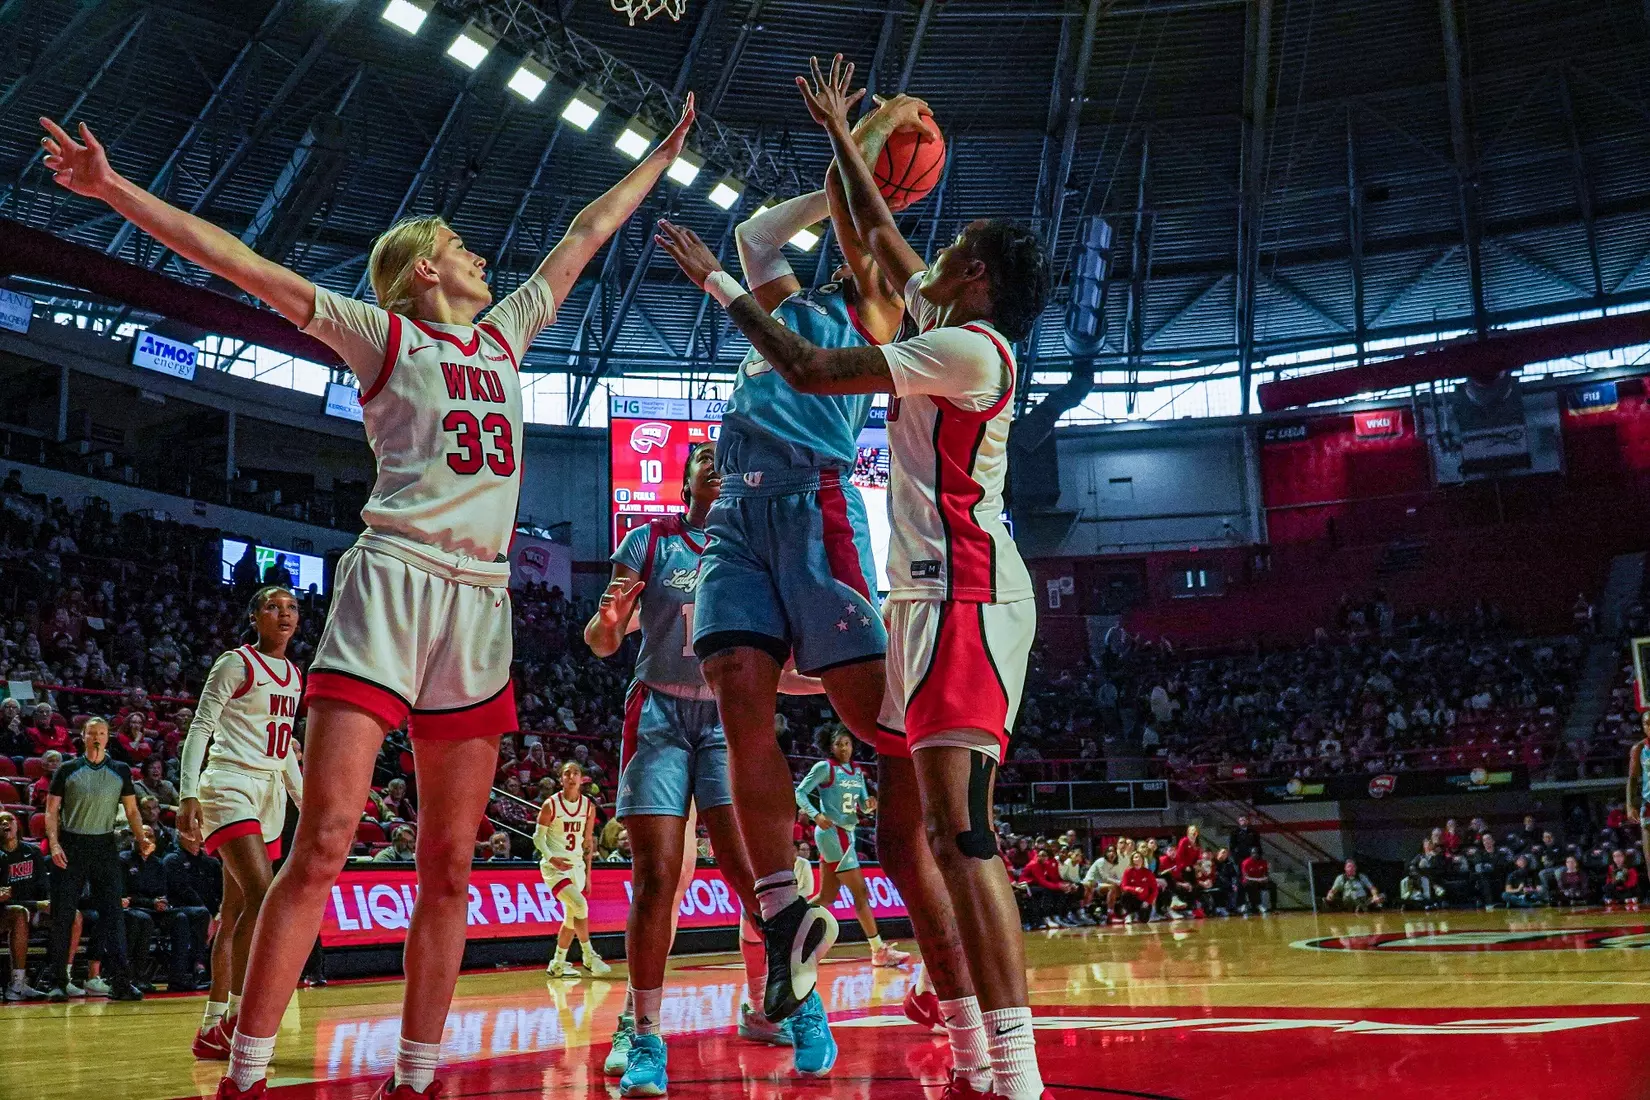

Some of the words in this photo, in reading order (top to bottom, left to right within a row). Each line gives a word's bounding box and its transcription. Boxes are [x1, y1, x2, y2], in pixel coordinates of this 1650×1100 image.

[139, 335, 195, 366] ATMOS
[153, 357, 192, 376] energy
[439, 362, 506, 403] WKU
[1366, 418, 1390, 429] WKU
[442, 410, 516, 477] 33
[640, 460, 662, 484] 10
[619, 504, 642, 512] PLAYER
[643, 504, 665, 513] POINTS
[662, 567, 699, 593] Lady
[269, 693, 296, 717] WKU
[266, 721, 292, 760] 10
[563, 821, 582, 832] WKU
[565, 833, 576, 851] 3
[331, 883, 490, 931] LIQR
[489, 882, 565, 924] BAR
